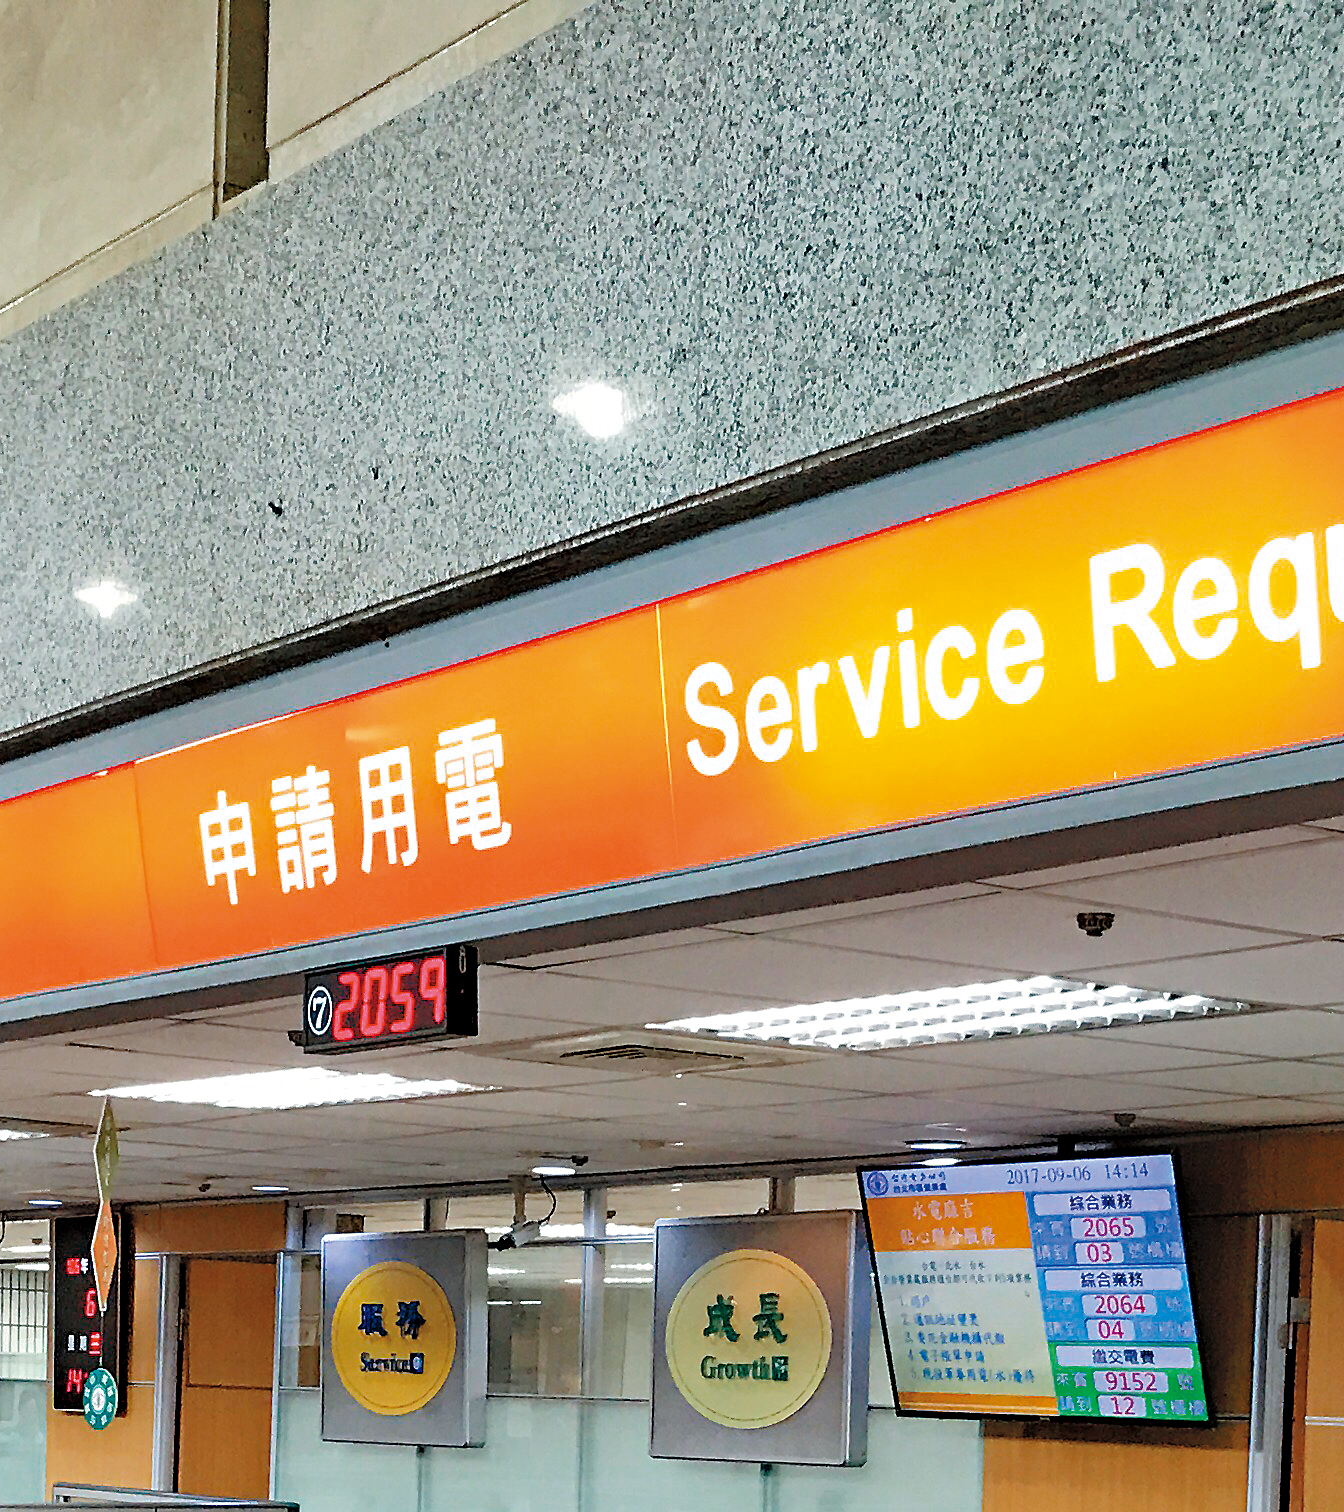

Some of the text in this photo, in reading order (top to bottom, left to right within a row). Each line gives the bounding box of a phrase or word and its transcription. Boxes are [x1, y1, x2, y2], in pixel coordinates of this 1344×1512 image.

[685, 607, 1045, 777] Service
[199, 718, 512, 905] 申請用電
[332, 955, 447, 1041] 2059
[1006, 1162, 1149, 1185] 2017-09-06 14:14
[1082, 1216, 1135, 1238] 2065
[1086, 1243, 1113, 1263] 03
[1093, 1294, 1146, 1315] 2064
[702, 1292, 789, 1344] 成長
[1097, 1320, 1125, 1340] 04
[700, 1354, 771, 1380] Growth
[1105, 1371, 1158, 1391] 9152
[1110, 1395, 1136, 1416] 12
